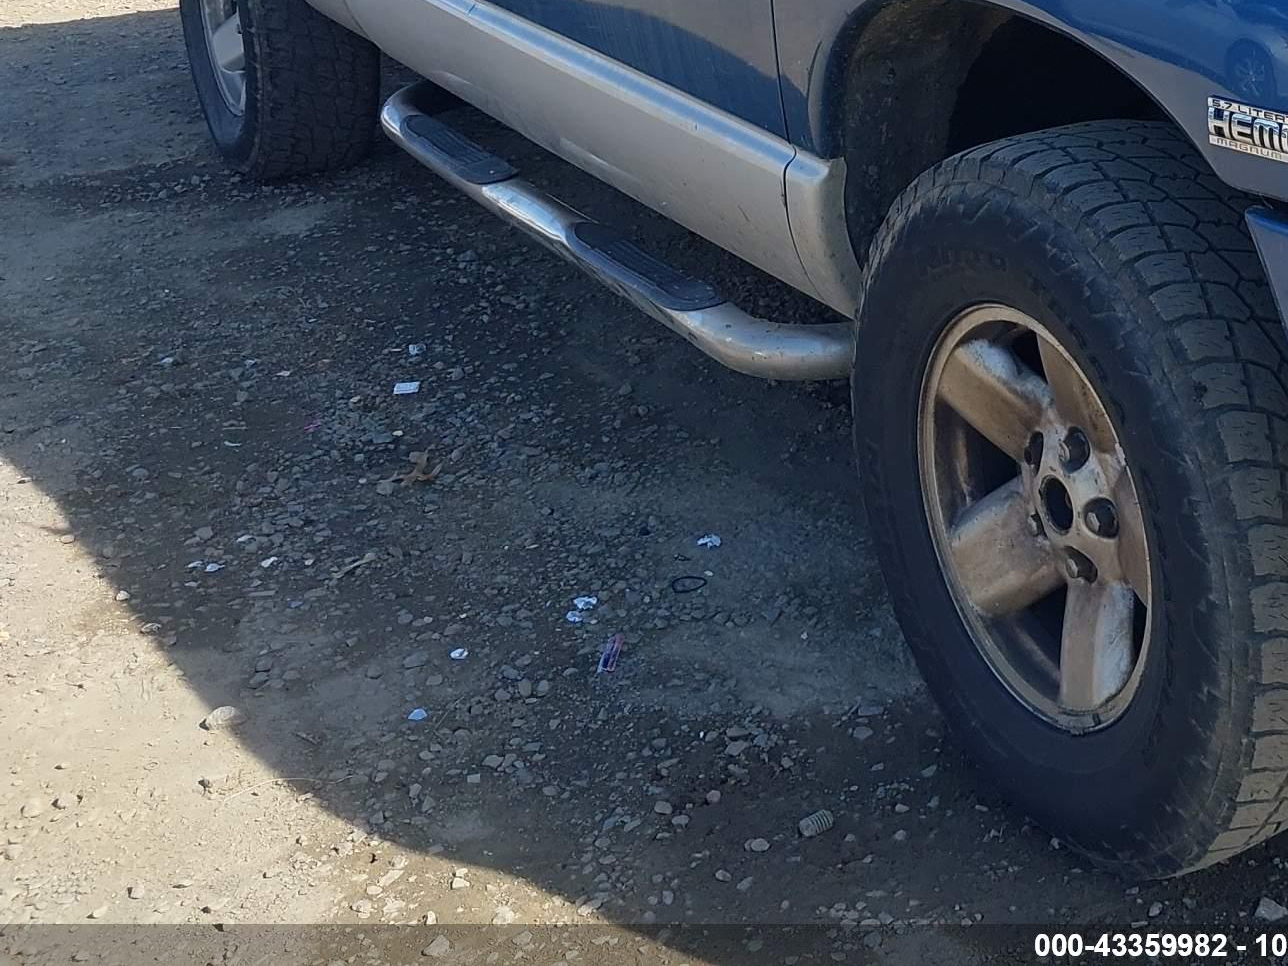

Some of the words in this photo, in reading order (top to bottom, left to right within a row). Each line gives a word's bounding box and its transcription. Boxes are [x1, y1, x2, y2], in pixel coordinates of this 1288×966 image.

[1212, 98, 1233, 110] 5.7
[1238, 105, 1286, 122] LITER
[1216, 137, 1284, 159] MAGNUM
